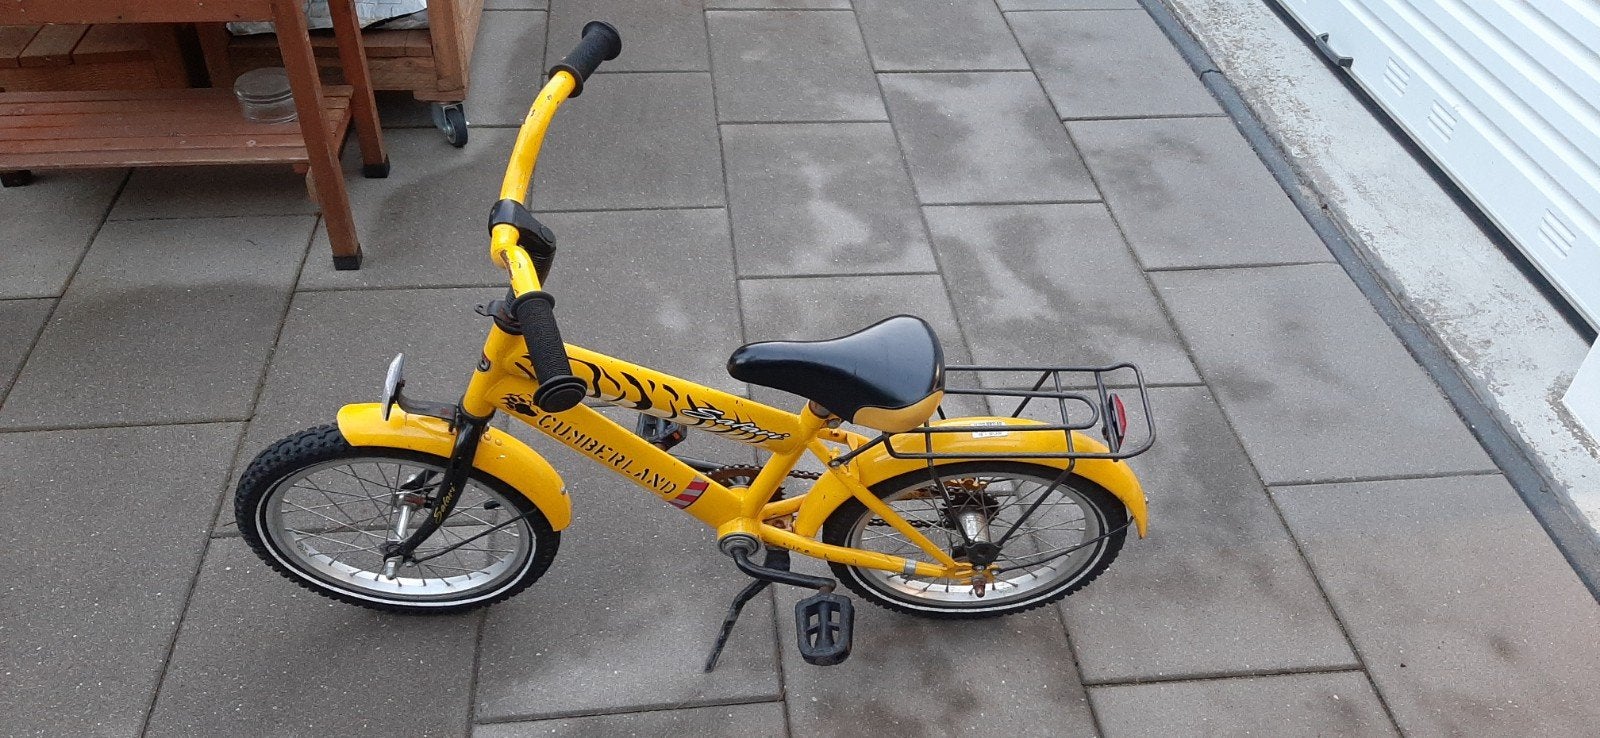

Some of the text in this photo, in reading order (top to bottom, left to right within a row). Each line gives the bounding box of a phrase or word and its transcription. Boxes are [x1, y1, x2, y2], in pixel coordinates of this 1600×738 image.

[681, 406, 790, 440] Safari
[537, 414, 677, 494] CUMBERLAND
[433, 482, 456, 524] Safari
